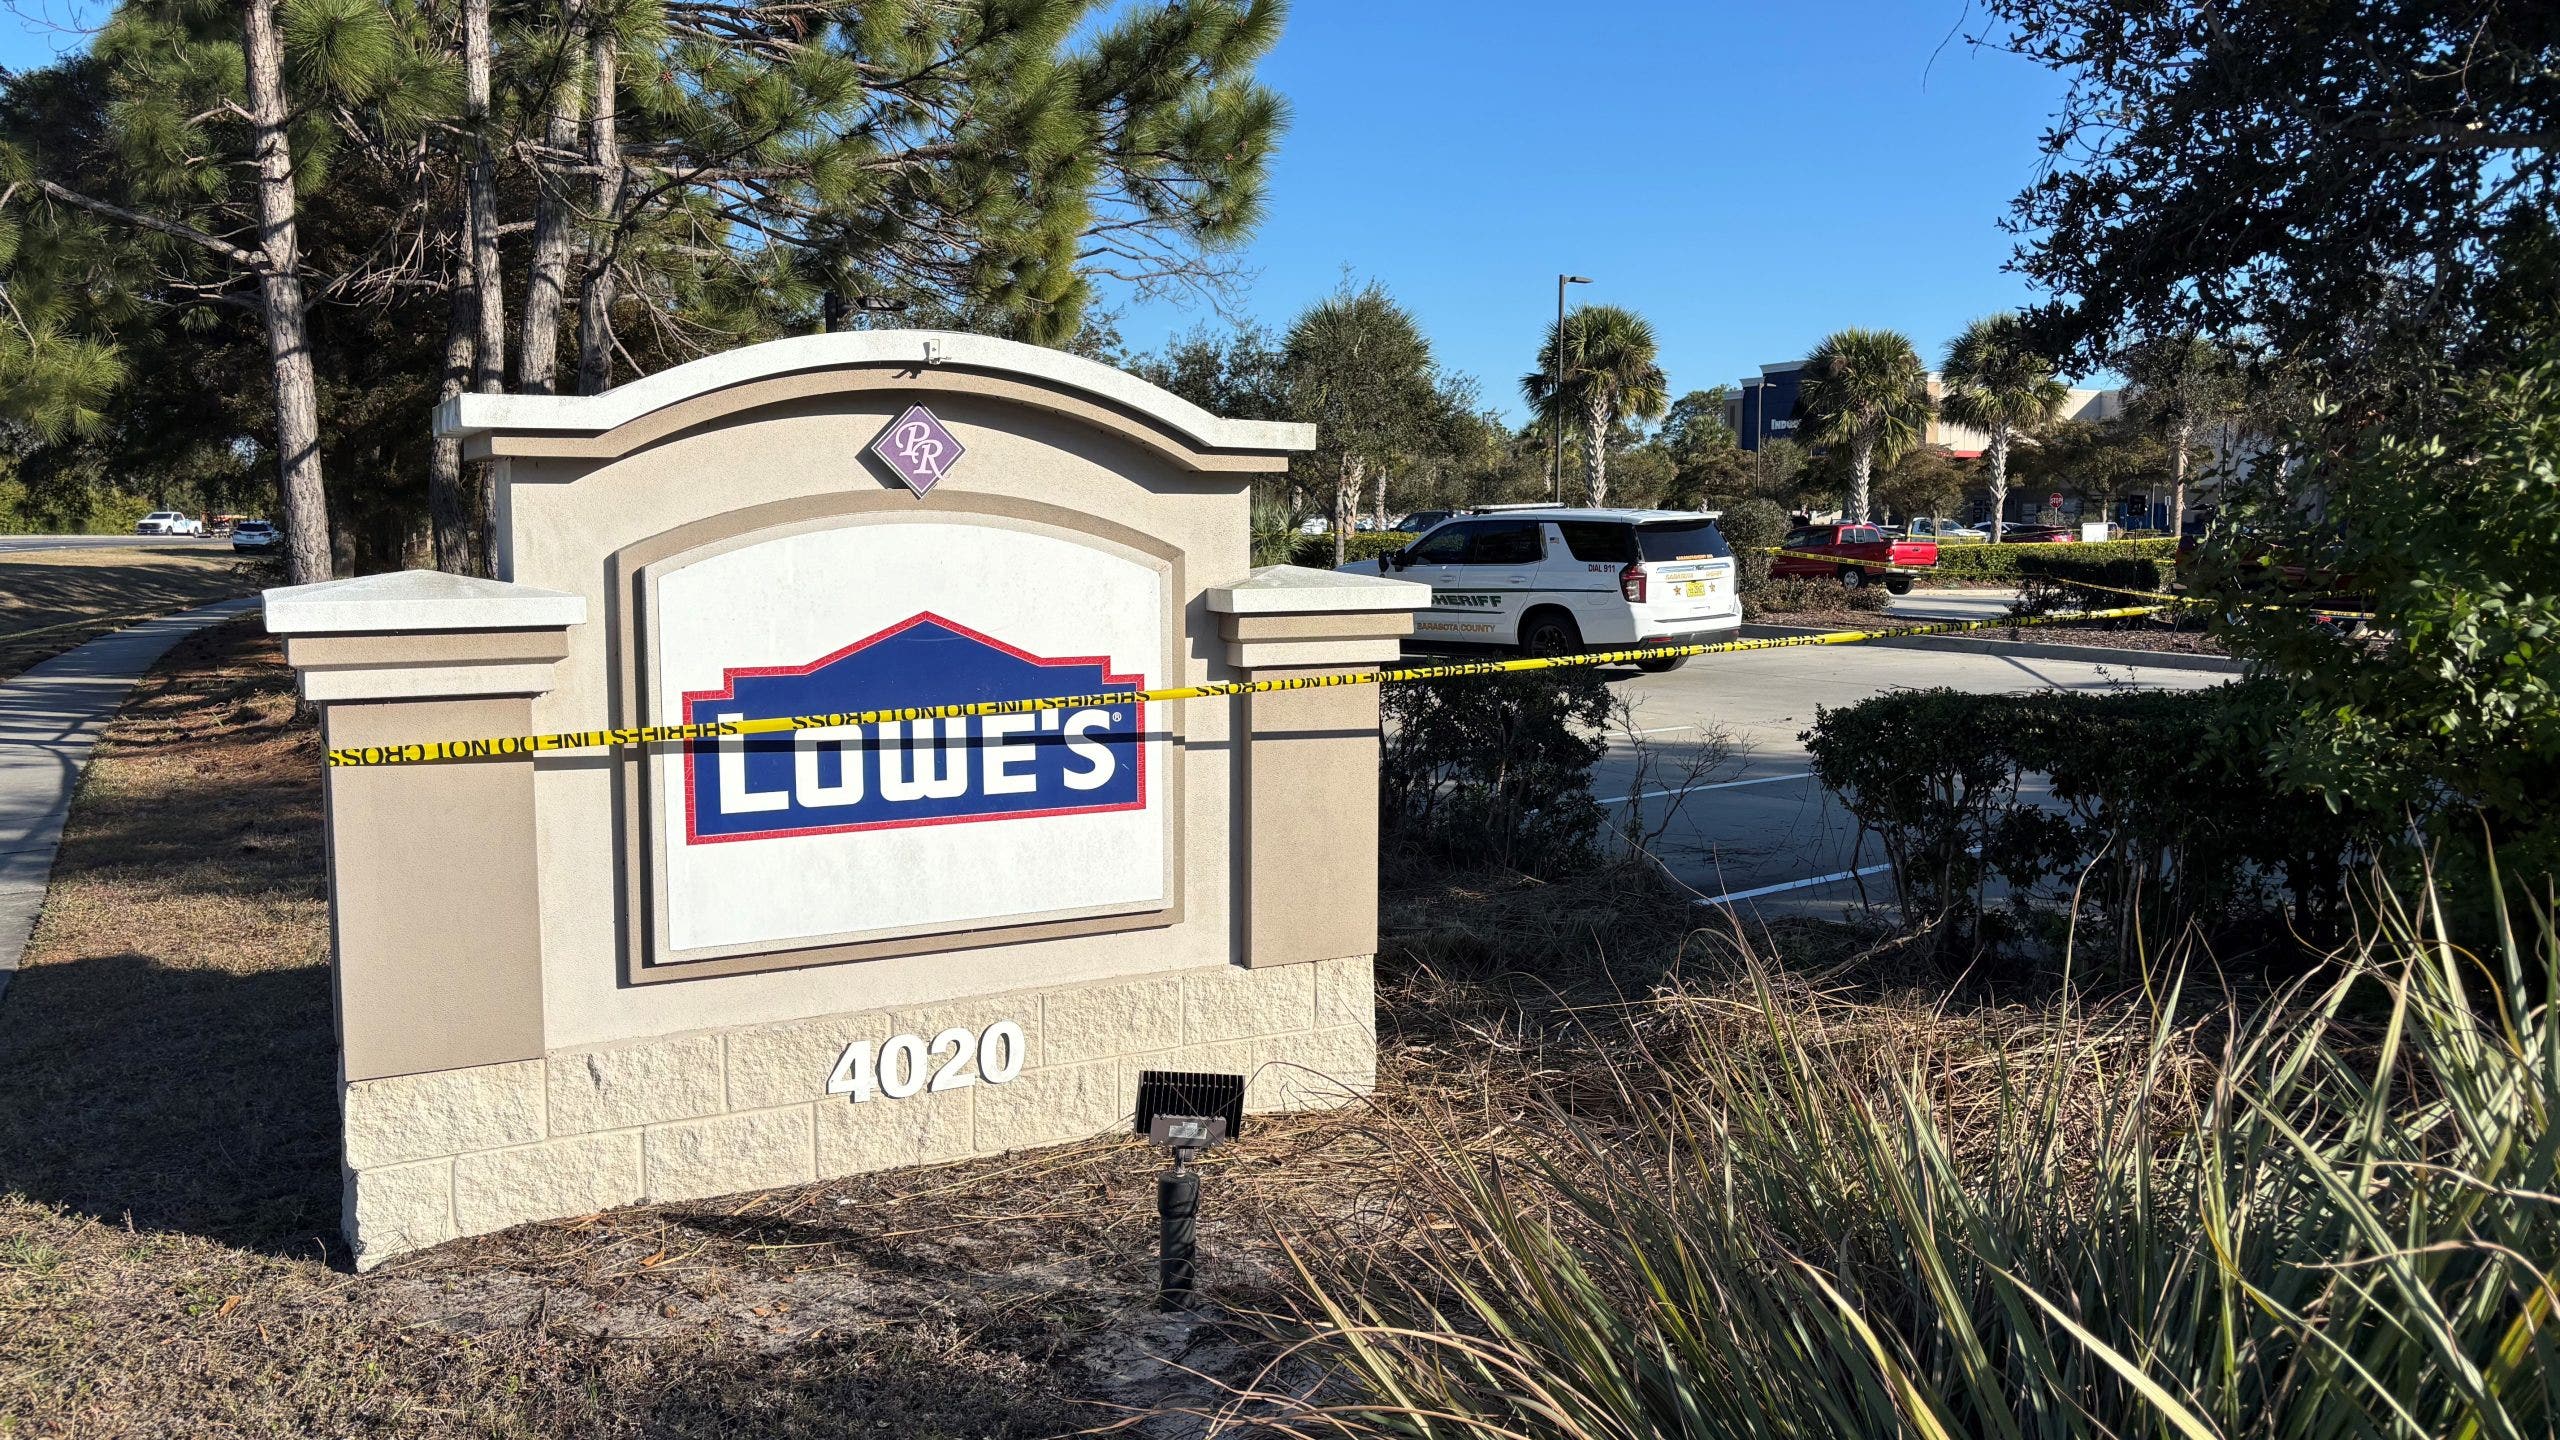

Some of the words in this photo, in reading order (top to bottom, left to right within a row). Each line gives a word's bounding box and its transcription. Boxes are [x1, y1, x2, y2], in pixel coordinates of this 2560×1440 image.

[2050, 497, 2063, 505] STOP
[1588, 564, 1602, 573] DIAL
[1604, 564, 1616, 573] 911
[1431, 595, 1502, 607] HERIFF
[1416, 622, 1459, 633] SARASOTA
[1460, 624, 1496, 633] COUNTY
[792, 710, 880, 730] CROSS
[718, 708, 1116, 814] LOWE'S
[827, 1020, 1026, 1103] 4020
